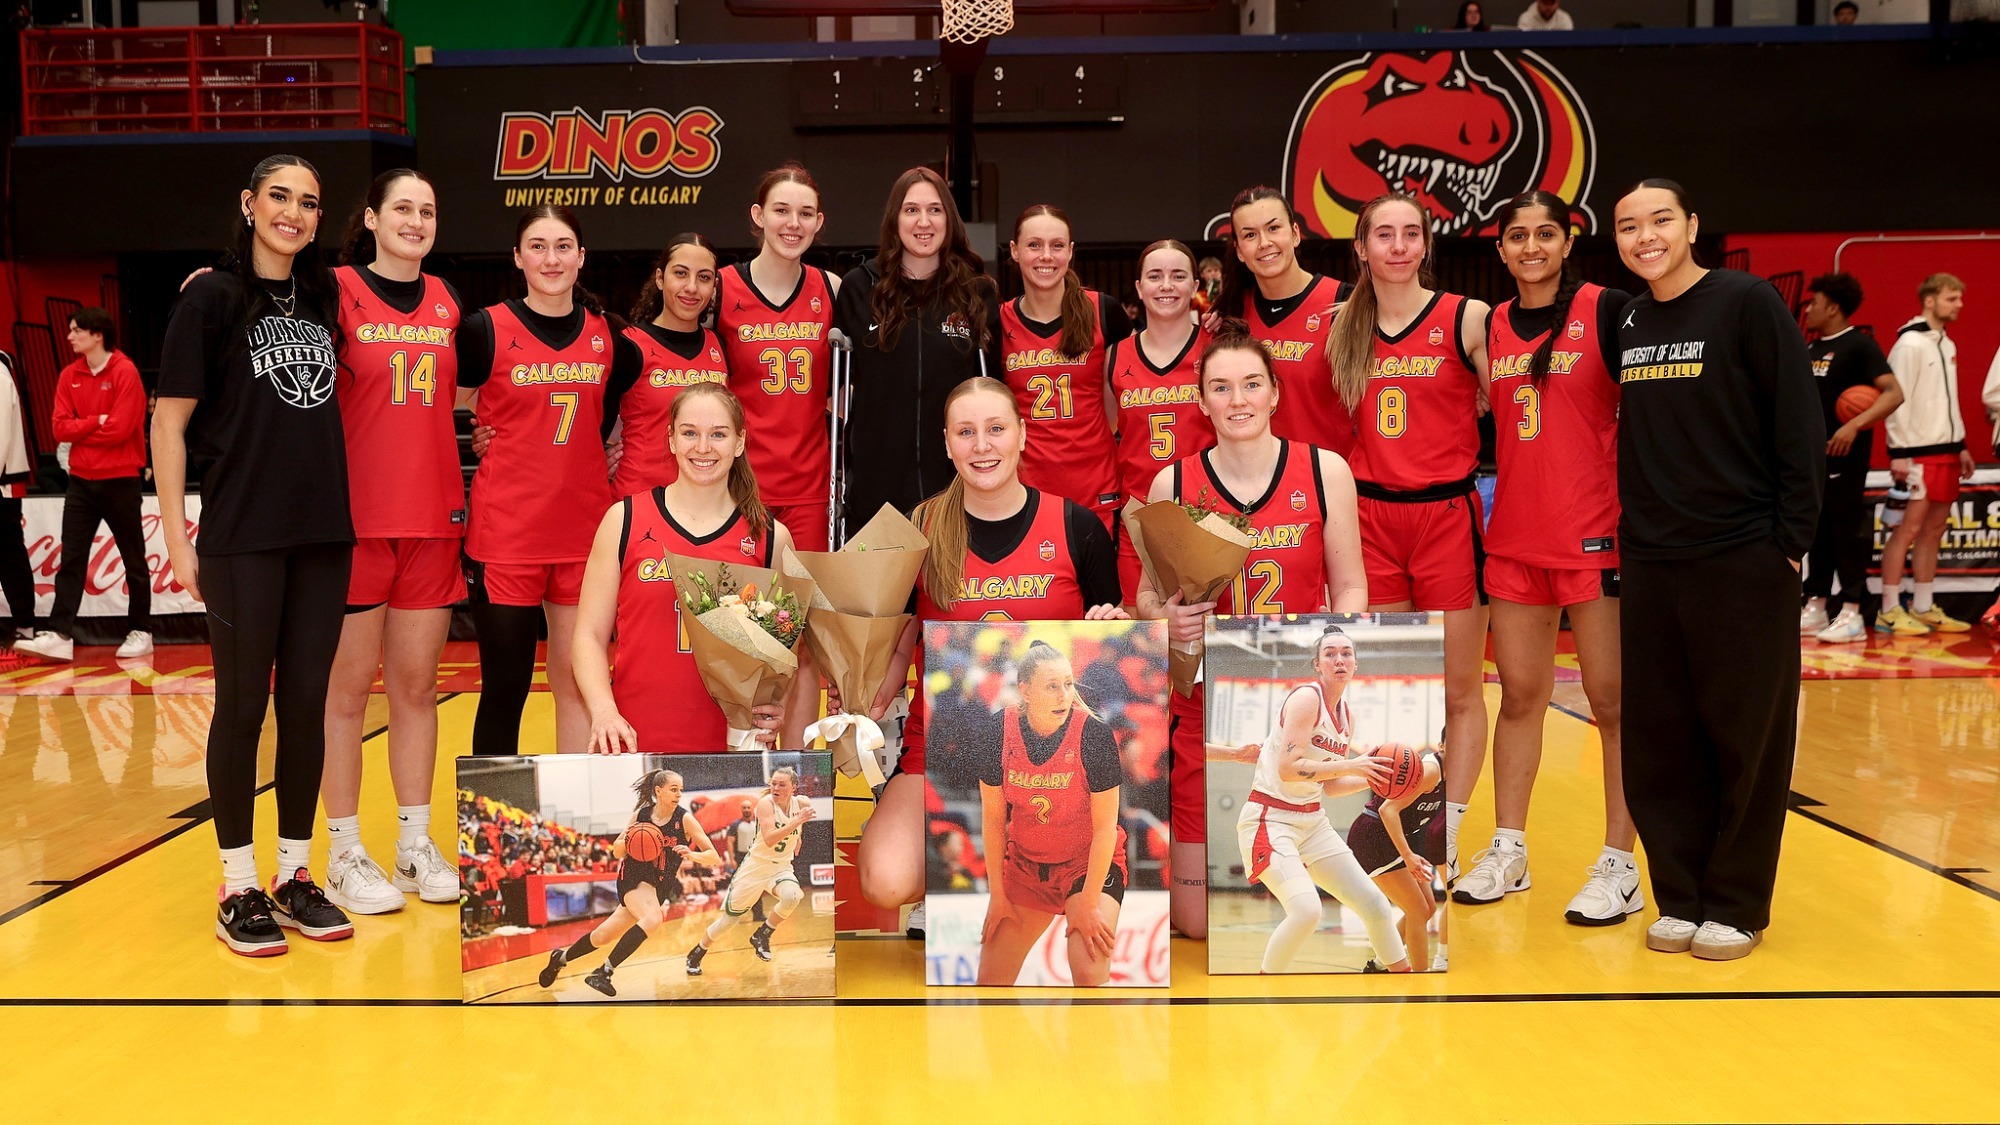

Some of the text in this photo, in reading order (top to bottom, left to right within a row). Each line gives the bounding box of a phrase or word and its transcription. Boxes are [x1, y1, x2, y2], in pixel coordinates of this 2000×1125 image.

[833, 66, 1085, 84] 1 2 3 4
[494, 106, 725, 182] DINOS
[505, 185, 701, 207] UNIVERSITY OF CALGARY
[356, 322, 451, 347] CALGARY
[738, 322, 824, 342] CALGARY
[252, 347, 335, 375] BASKETBAL
[1006, 347, 1088, 371] CALGAY
[1261, 339, 1314, 361] GARY
[1657, 344, 1669, 361] OF
[1669, 341, 1705, 360] CALGARY
[390, 351, 436, 406] 14
[511, 362, 605, 386] CALGARY
[759, 347, 813, 395] 33
[1369, 355, 1445, 379] LGARY
[1490, 351, 1583, 382] CALGRY
[1027, 373, 1074, 420] 21
[551, 392, 579, 444] 7
[1377, 386, 1407, 439] 8
[1514, 384, 1541, 441] 3
[1148, 413, 1175, 461] 5
[1246, 523, 1310, 551] GARY
[955, 574, 1055, 602] ALGARY
[1231, 559, 1283, 614] 12
[1007, 769, 1075, 790] CALGARY
